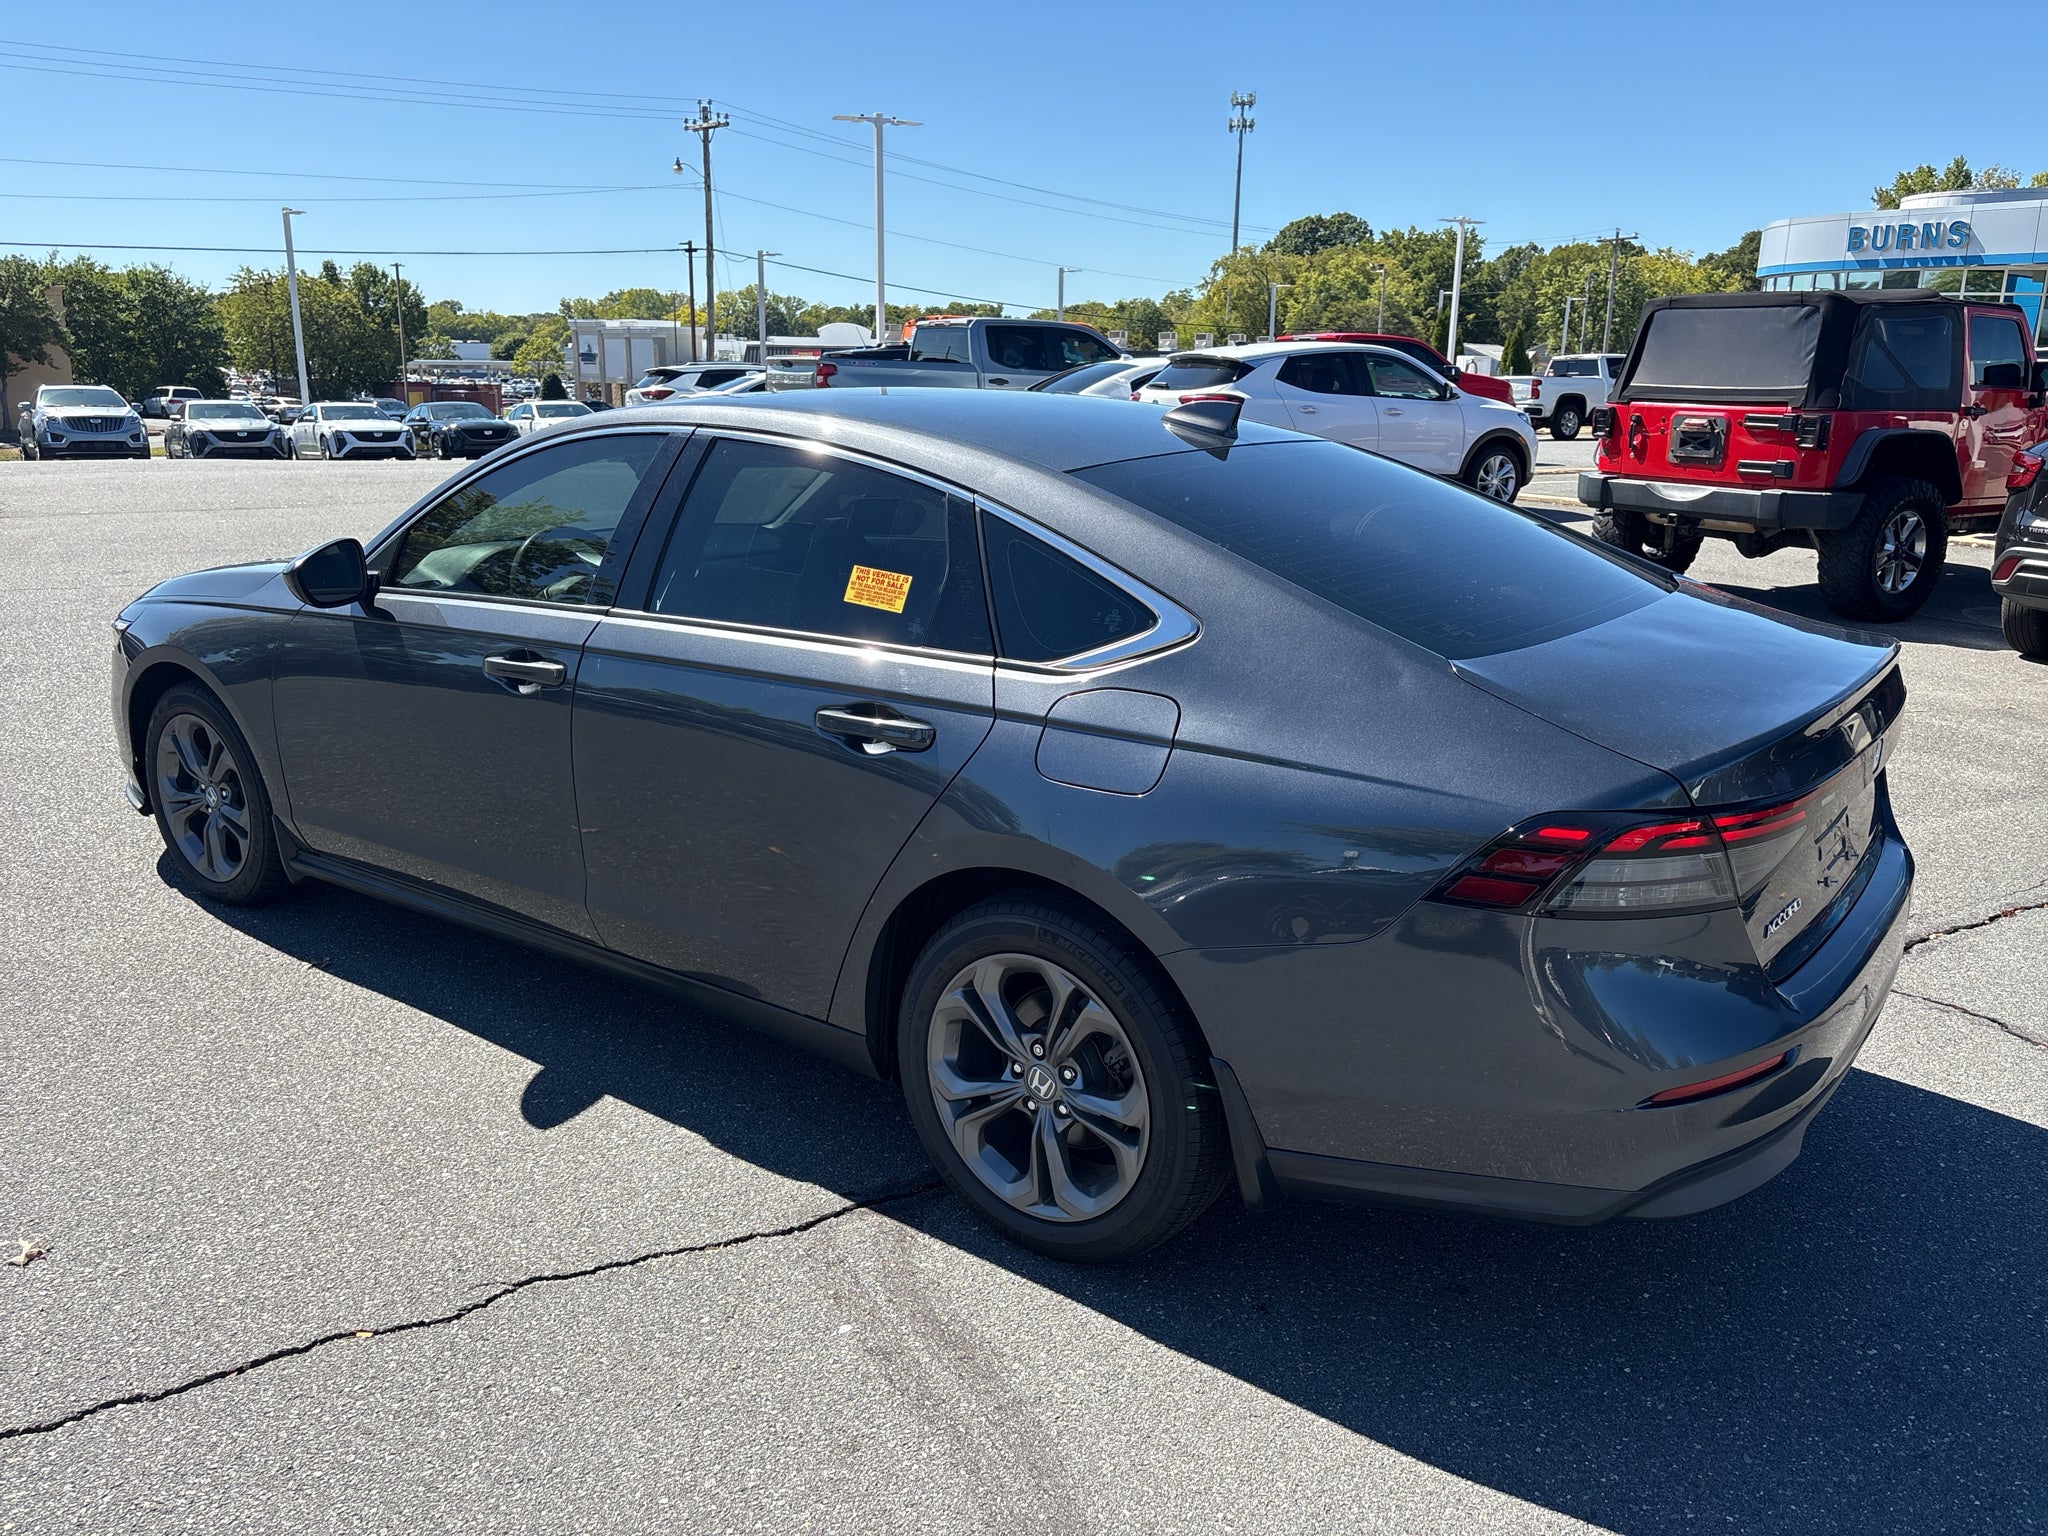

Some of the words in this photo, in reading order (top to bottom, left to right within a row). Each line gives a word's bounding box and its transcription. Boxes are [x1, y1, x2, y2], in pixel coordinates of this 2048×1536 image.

[1847, 220, 1970, 252] BURNS
[855, 567, 870, 576] THIS
[872, 570, 901, 582] VEHICLE
[902, 576, 909, 584] IS
[856, 575, 869, 583] NOT
[871, 578, 884, 586] FOR
[886, 580, 904, 590] SALE
[1764, 897, 1801, 938] ACCORD
[1055, 936, 1124, 994] MICHELIN
